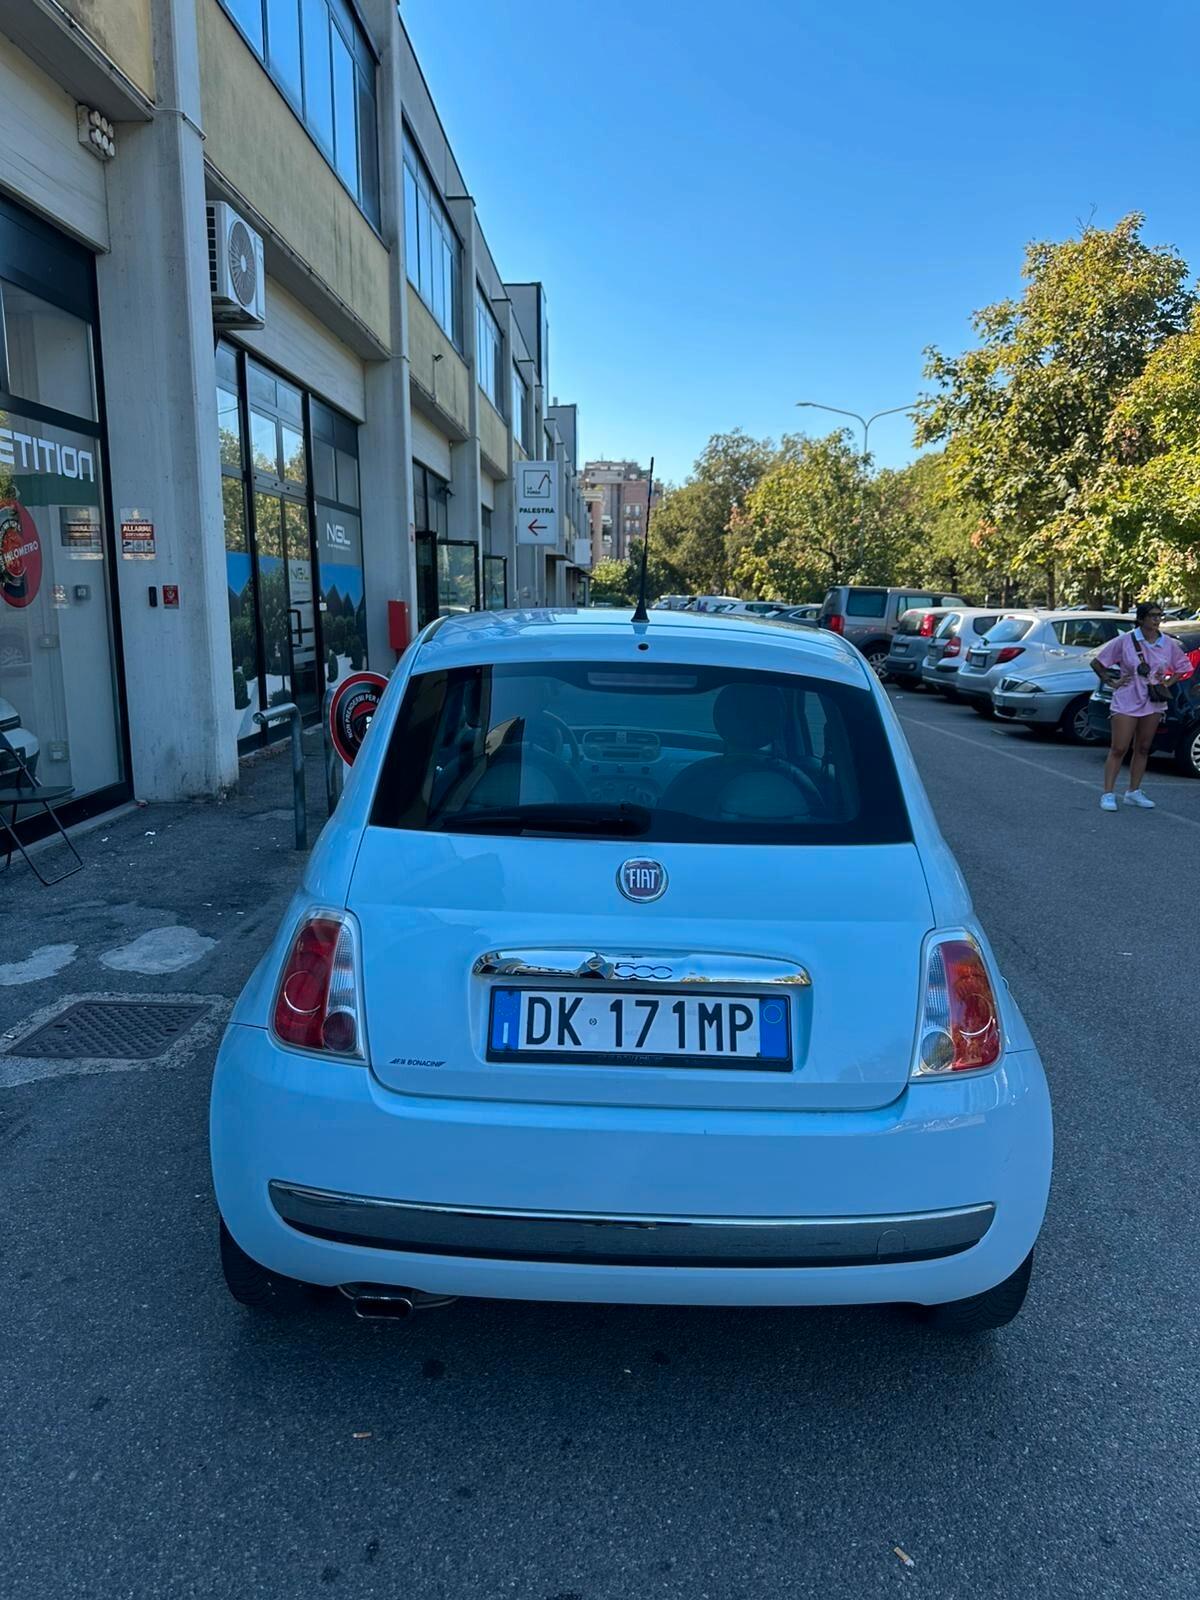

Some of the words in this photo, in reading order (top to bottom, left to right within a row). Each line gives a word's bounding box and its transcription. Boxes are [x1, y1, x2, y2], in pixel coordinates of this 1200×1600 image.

[627, 868, 656, 889] FIAT
[614, 962, 673, 980] 500
[526, 996, 584, 1046] DK
[609, 999, 754, 1052] 171MP
